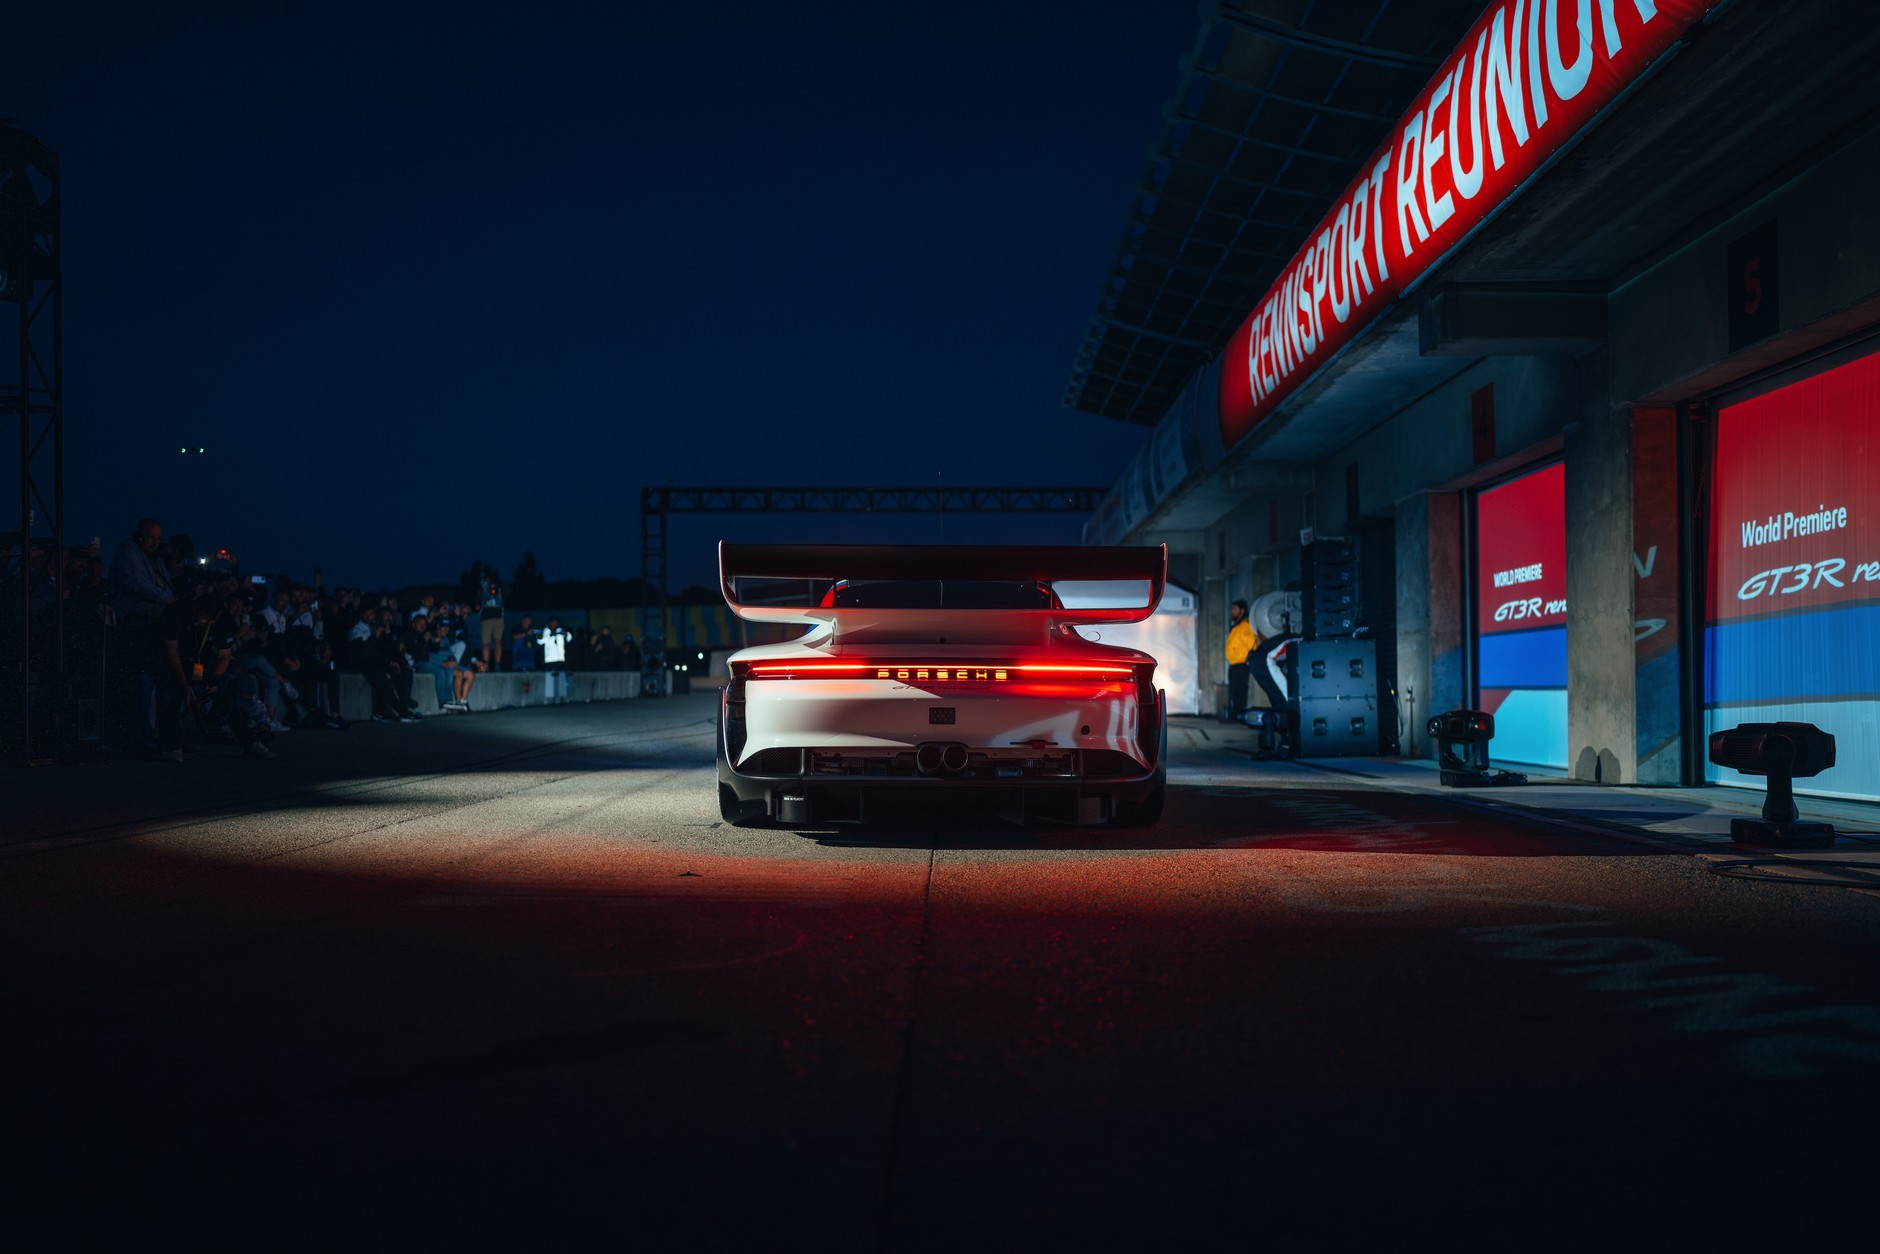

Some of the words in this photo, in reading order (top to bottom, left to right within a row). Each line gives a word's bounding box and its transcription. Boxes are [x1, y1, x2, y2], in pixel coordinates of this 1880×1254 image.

[1249, 144, 1394, 408] RENNSPORT
[1743, 257, 1762, 315] 5
[1741, 514, 1781, 549] World
[1783, 504, 1847, 540] Premiere
[1493, 569, 1514, 588] WORLD
[1514, 562, 1543, 584] PREMIERE
[877, 670, 1008, 680] PORSCHE
